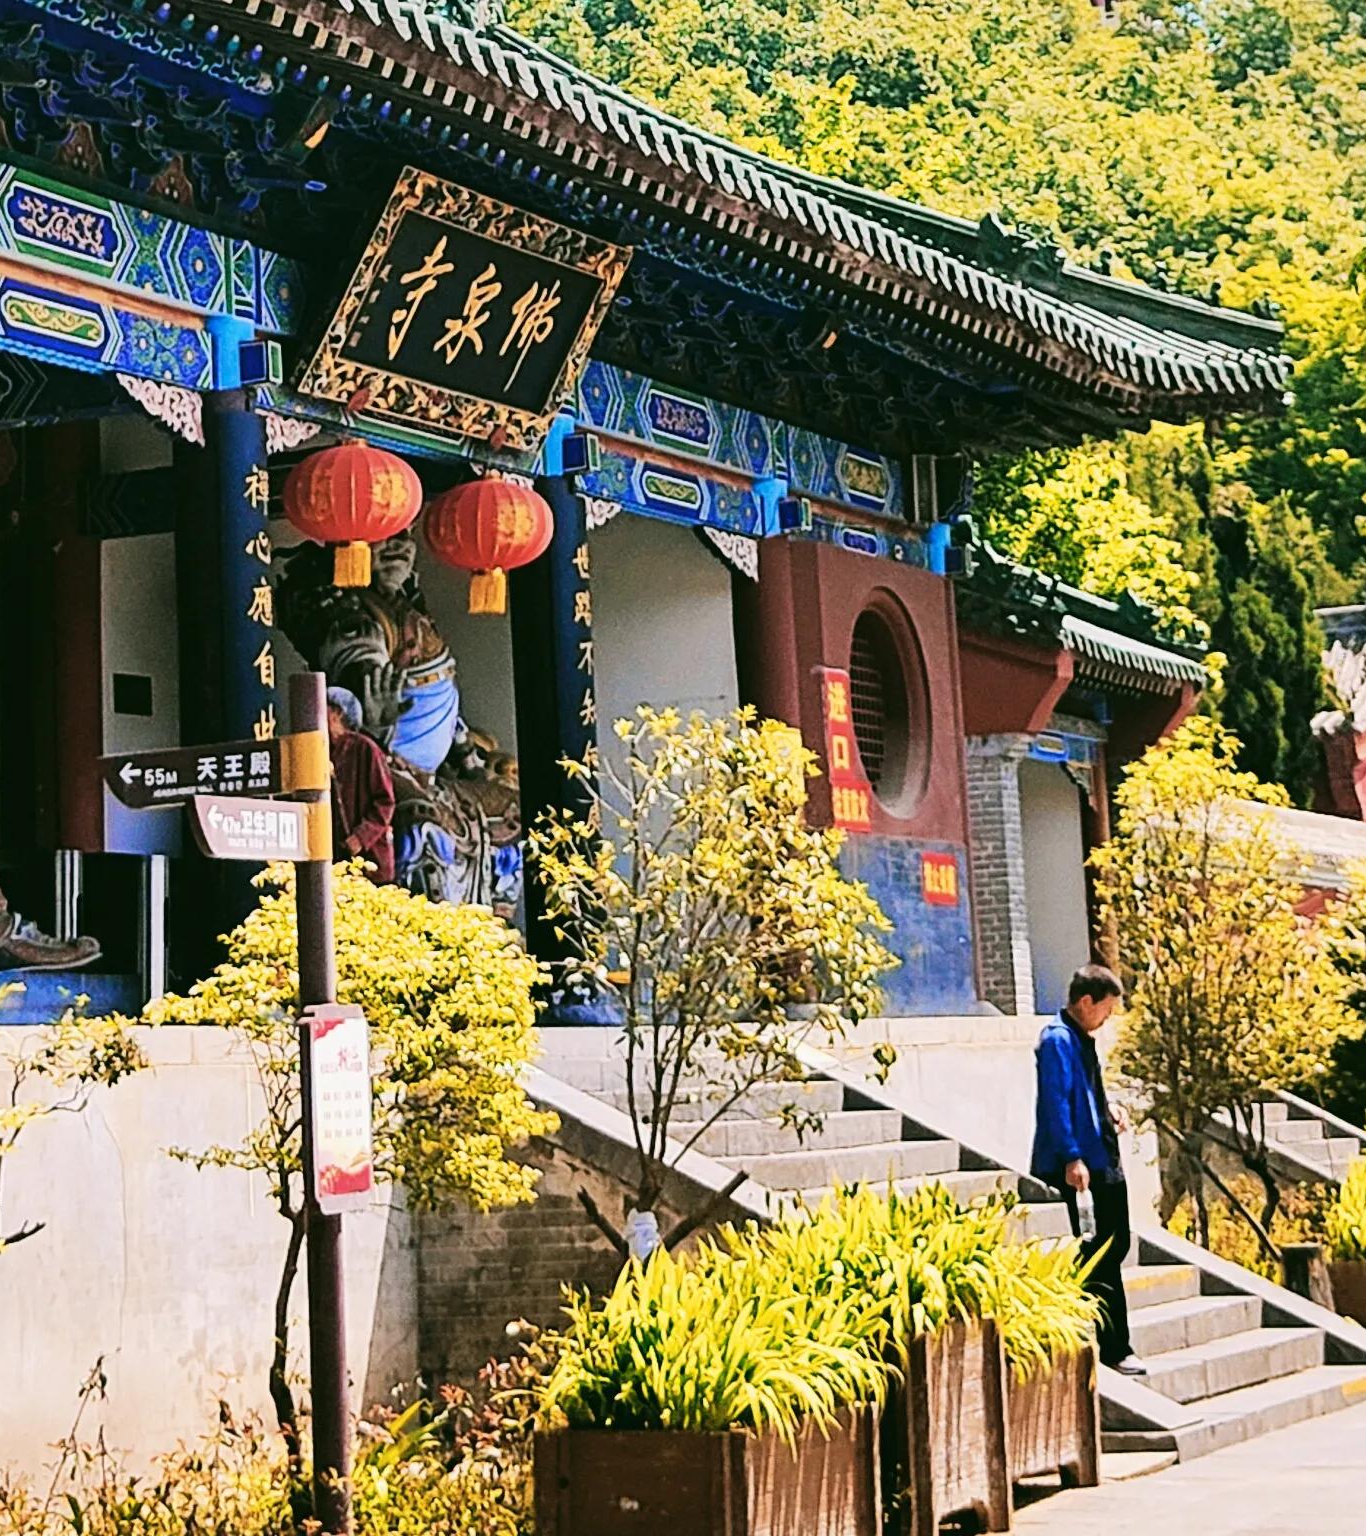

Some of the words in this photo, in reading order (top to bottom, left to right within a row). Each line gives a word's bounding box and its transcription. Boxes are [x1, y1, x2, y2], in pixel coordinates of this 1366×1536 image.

[388, 234, 562, 393] 佛泉寺
[196, 750, 271, 782] 天王殿
[241, 810, 278, 837] 卫生间
